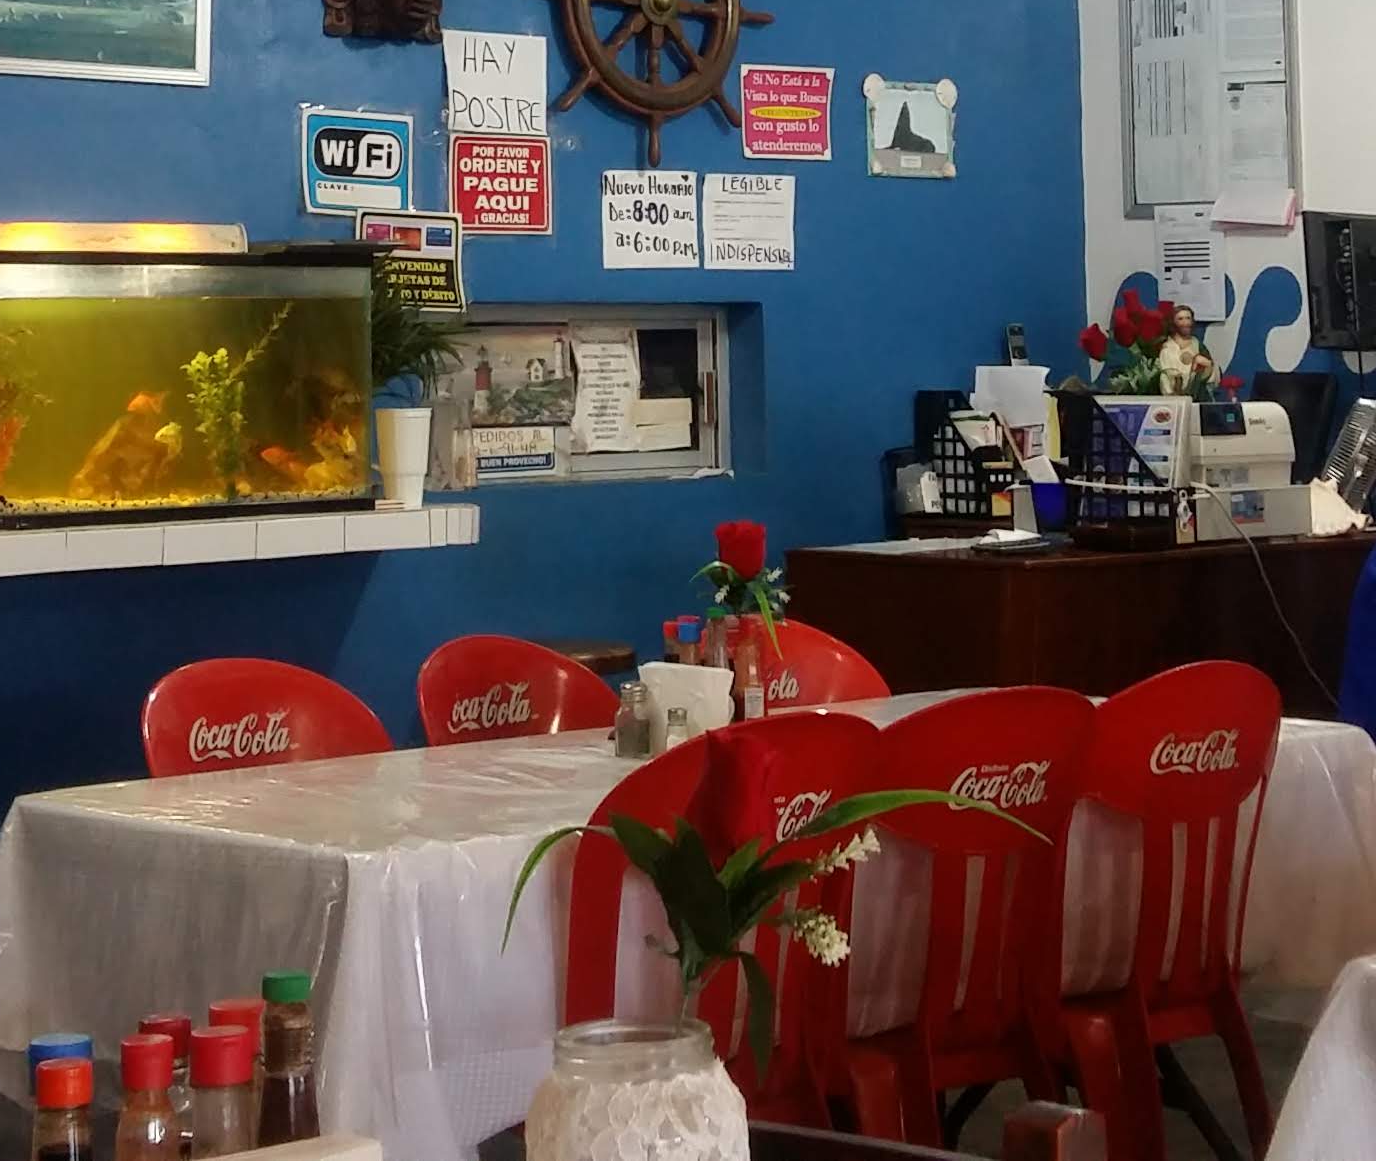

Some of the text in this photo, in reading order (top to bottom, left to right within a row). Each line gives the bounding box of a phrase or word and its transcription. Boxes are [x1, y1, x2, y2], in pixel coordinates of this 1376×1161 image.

[463, 37, 517, 75] HAY
[765, 73, 780, 86] No
[803, 79, 811, 87] a
[811, 75, 821, 87] la
[745, 89, 768, 103] Vista
[769, 90, 779, 102] lo
[780, 93, 798, 106] que
[452, 88, 545, 133] POSTRE
[752, 118, 820, 136] con gusto lo
[472, 145, 530, 159] POR FAVOR
[751, 137, 823, 152] atenderemos
[459, 157, 542, 175] ORDENE Y
[463, 176, 539, 193] PAGUE
[604, 175, 645, 196] Nuevo
[722, 176, 784, 192] LEGIBLE
[474, 194, 530, 213] AQUI
